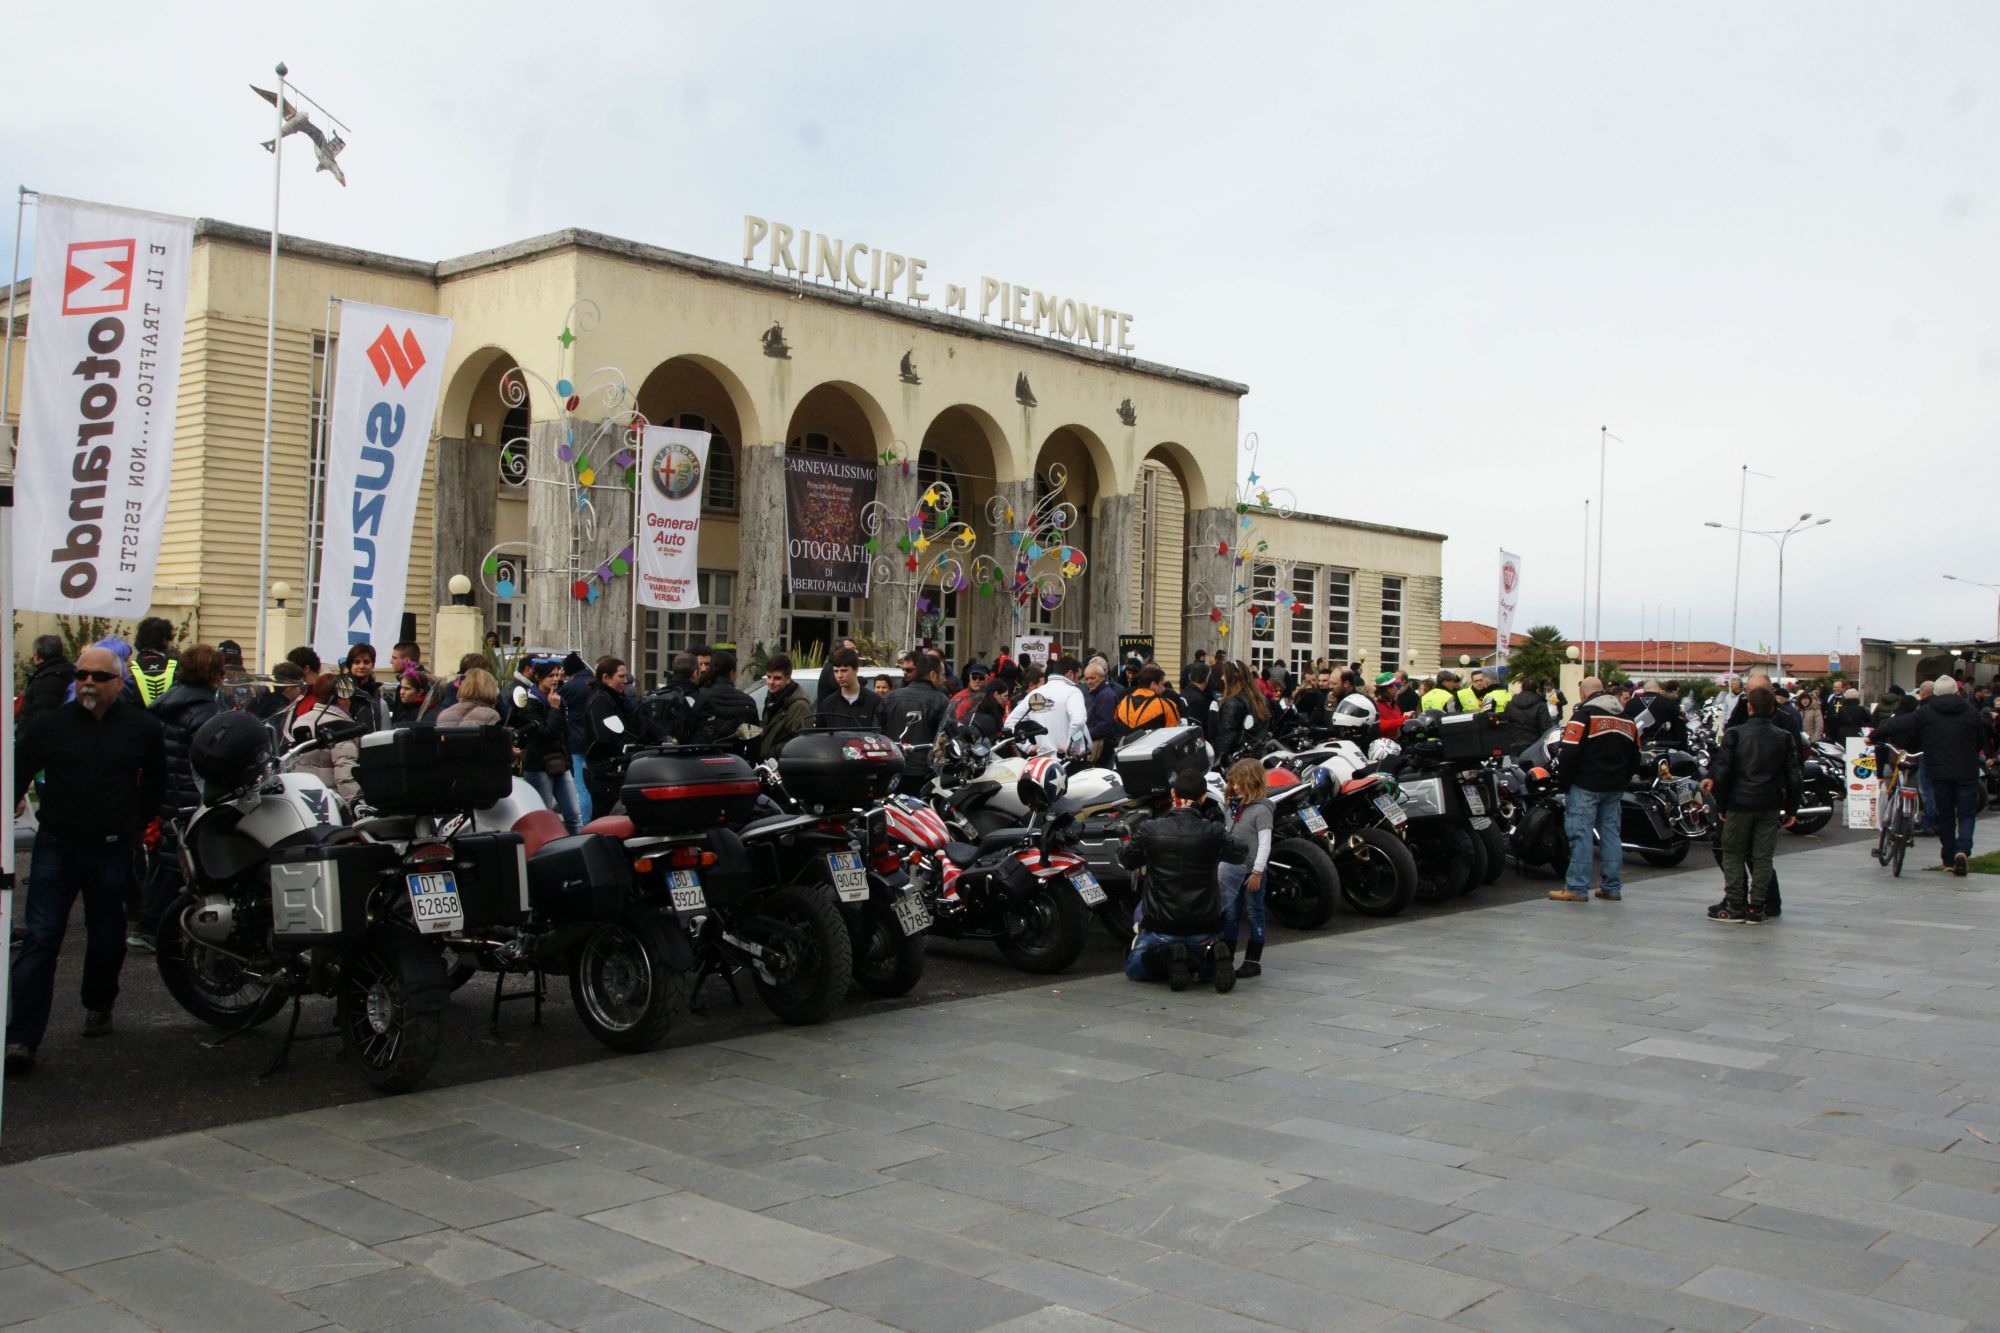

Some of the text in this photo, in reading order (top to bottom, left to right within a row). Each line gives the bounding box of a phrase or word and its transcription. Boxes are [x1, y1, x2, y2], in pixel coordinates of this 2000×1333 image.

[743, 214, 1136, 351] PRINCIPE DI PIEMONTE
[647, 512, 699, 531] General
[653, 530, 686, 546] Auto
[825, 567, 832, 577] DI
[421, 875, 437, 893] DT
[416, 896, 459, 916] 62858
